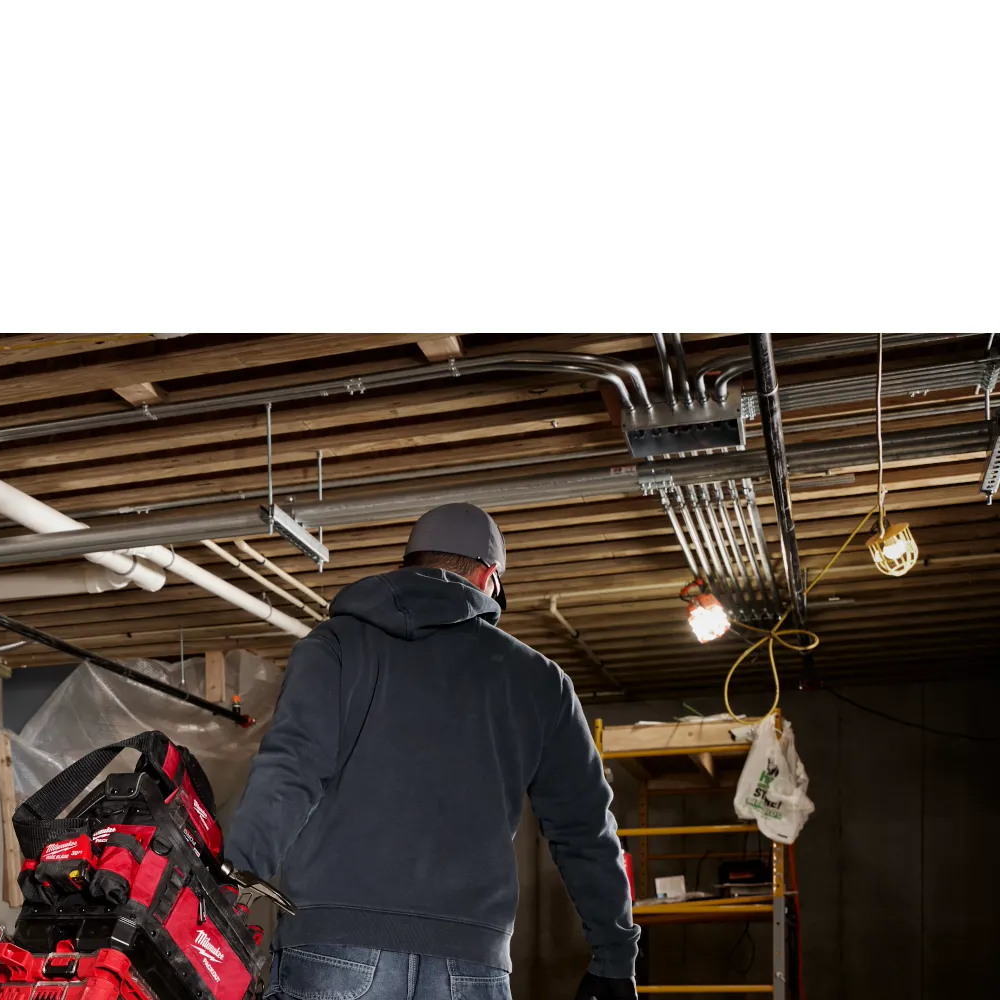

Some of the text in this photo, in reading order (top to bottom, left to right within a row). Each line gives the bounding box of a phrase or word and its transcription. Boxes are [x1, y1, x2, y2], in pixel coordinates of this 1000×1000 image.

[45, 840, 78, 854] Milwaukee
[194, 929, 225, 961] Milwaukee
[202, 957, 221, 983] PACKOUT
